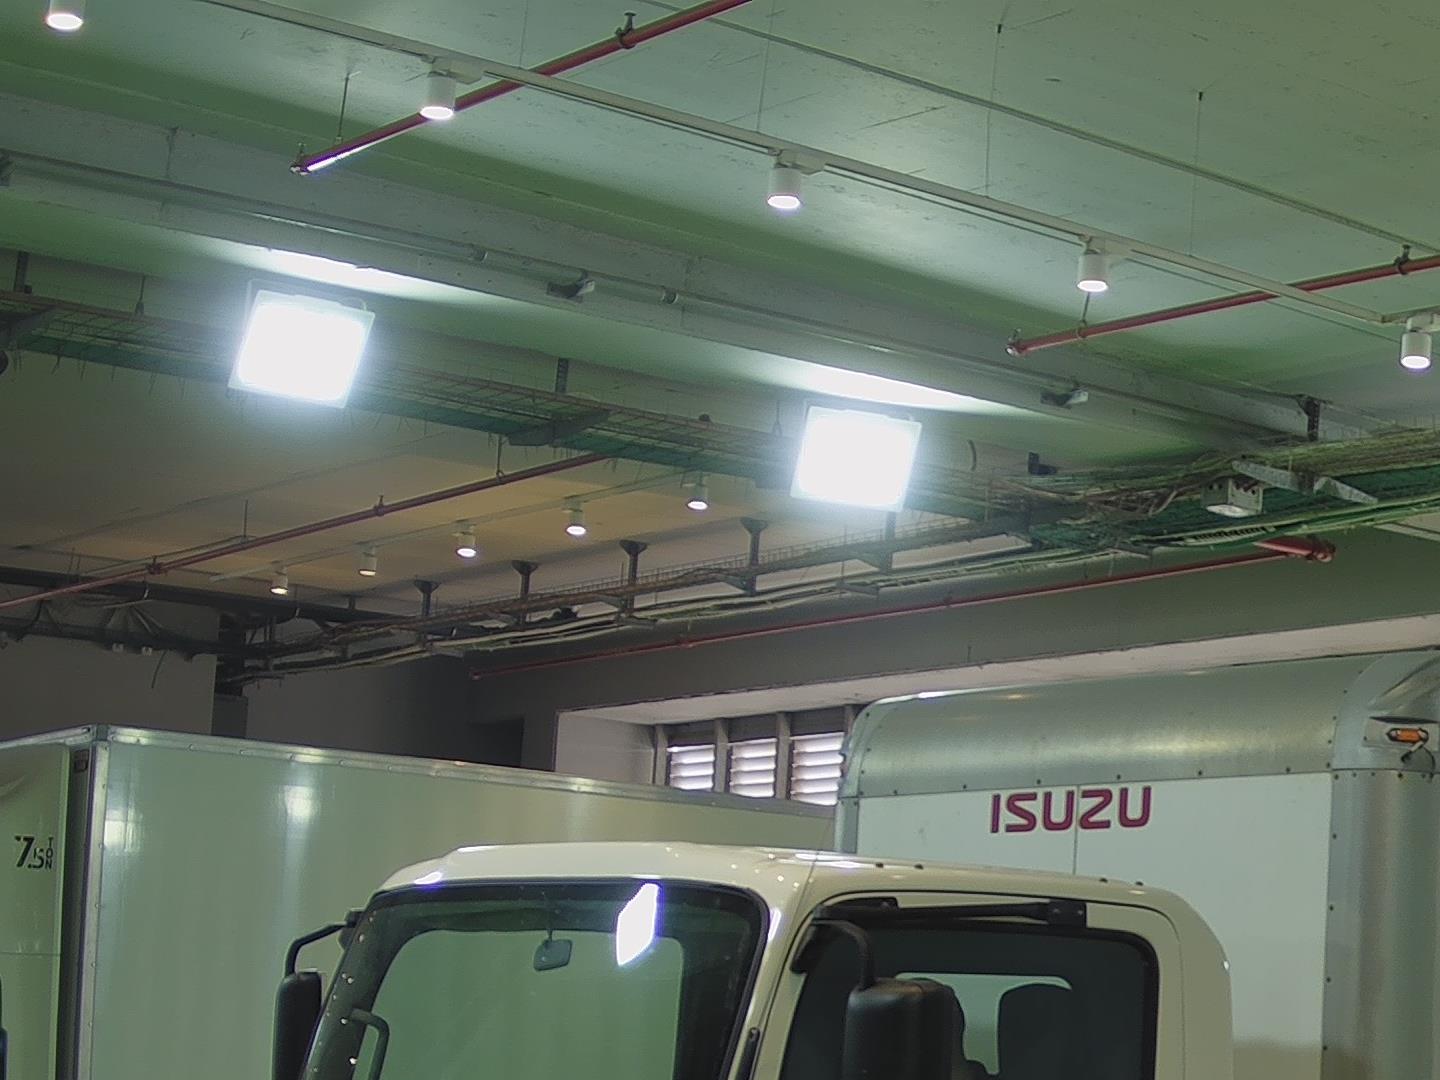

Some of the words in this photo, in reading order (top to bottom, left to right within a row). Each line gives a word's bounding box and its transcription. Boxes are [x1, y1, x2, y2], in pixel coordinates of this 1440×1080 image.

[990, 785, 1153, 834] ISUZU
[15, 835, 45, 869] 7.5
[45, 836, 54, 869] TON
